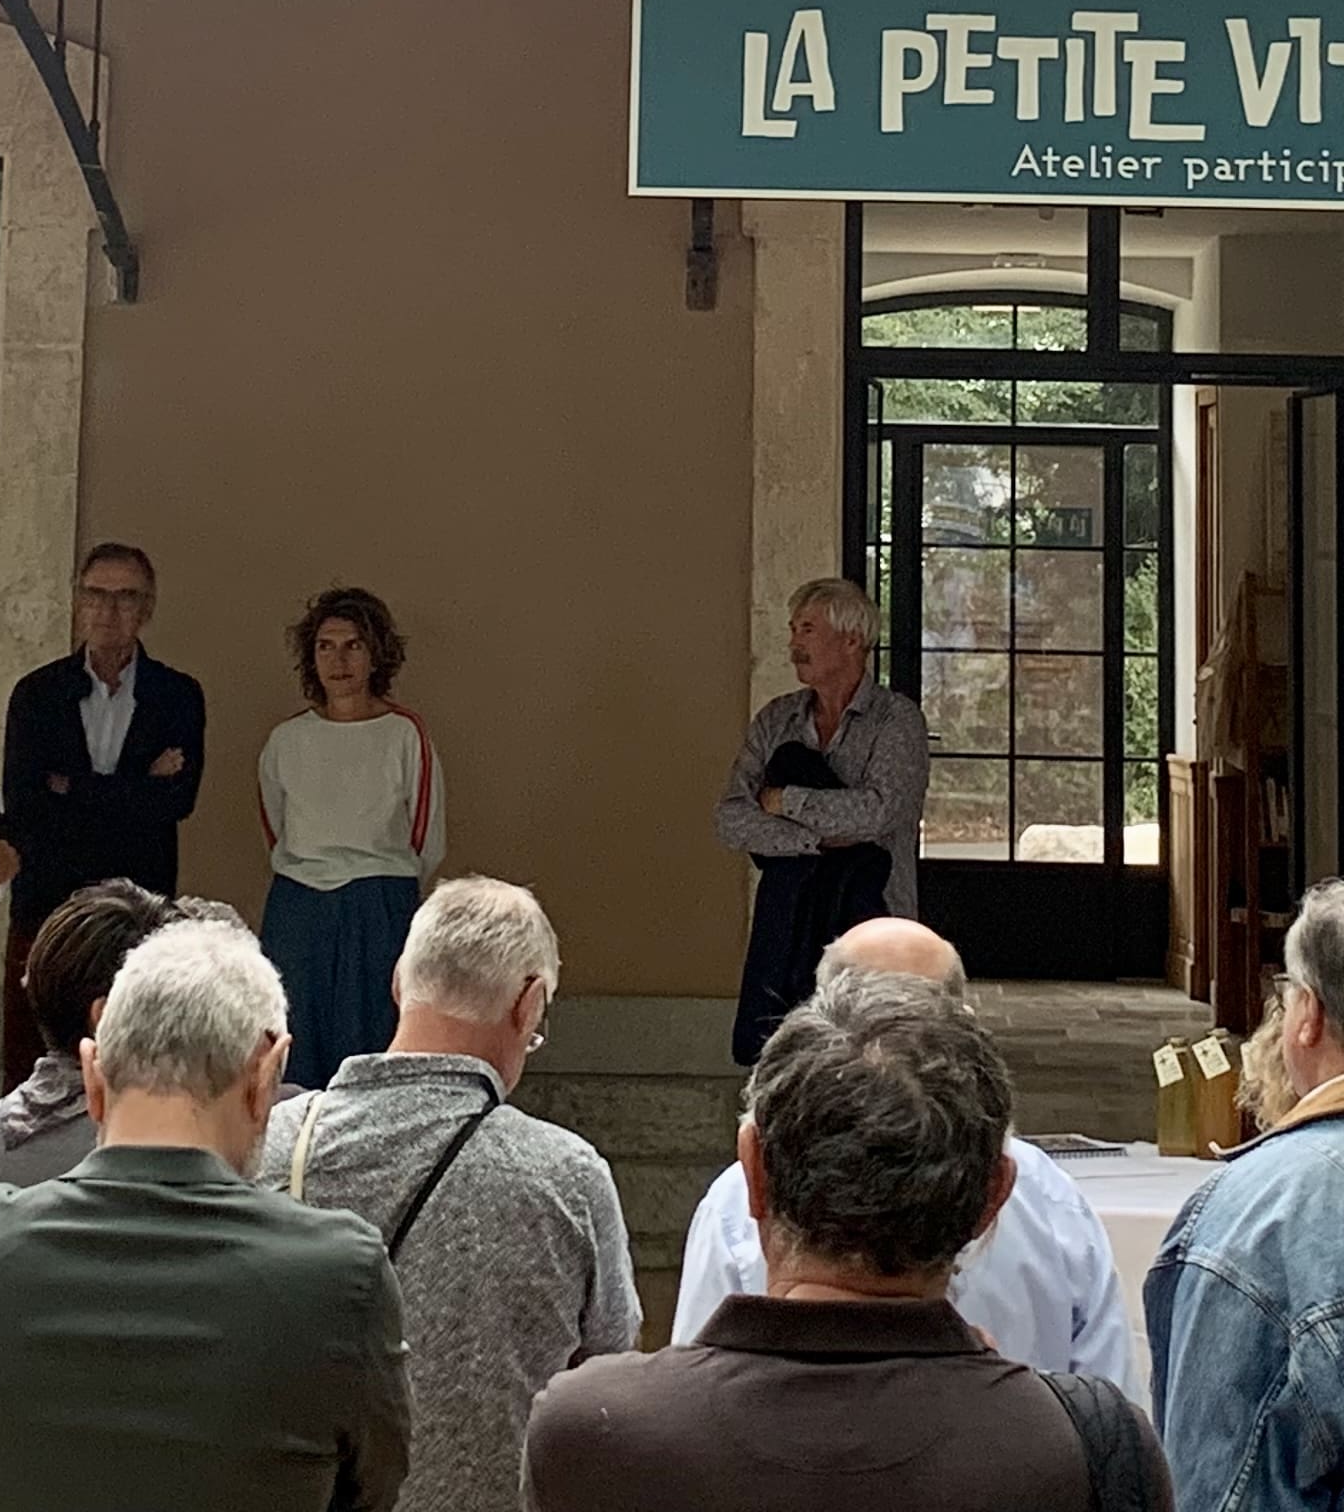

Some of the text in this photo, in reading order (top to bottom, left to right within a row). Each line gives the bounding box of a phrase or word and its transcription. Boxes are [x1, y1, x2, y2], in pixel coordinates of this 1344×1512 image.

[741, 9, 836, 138] LA
[880, 10, 1206, 141] PETITE
[1010, 143, 1163, 179] Atelier
